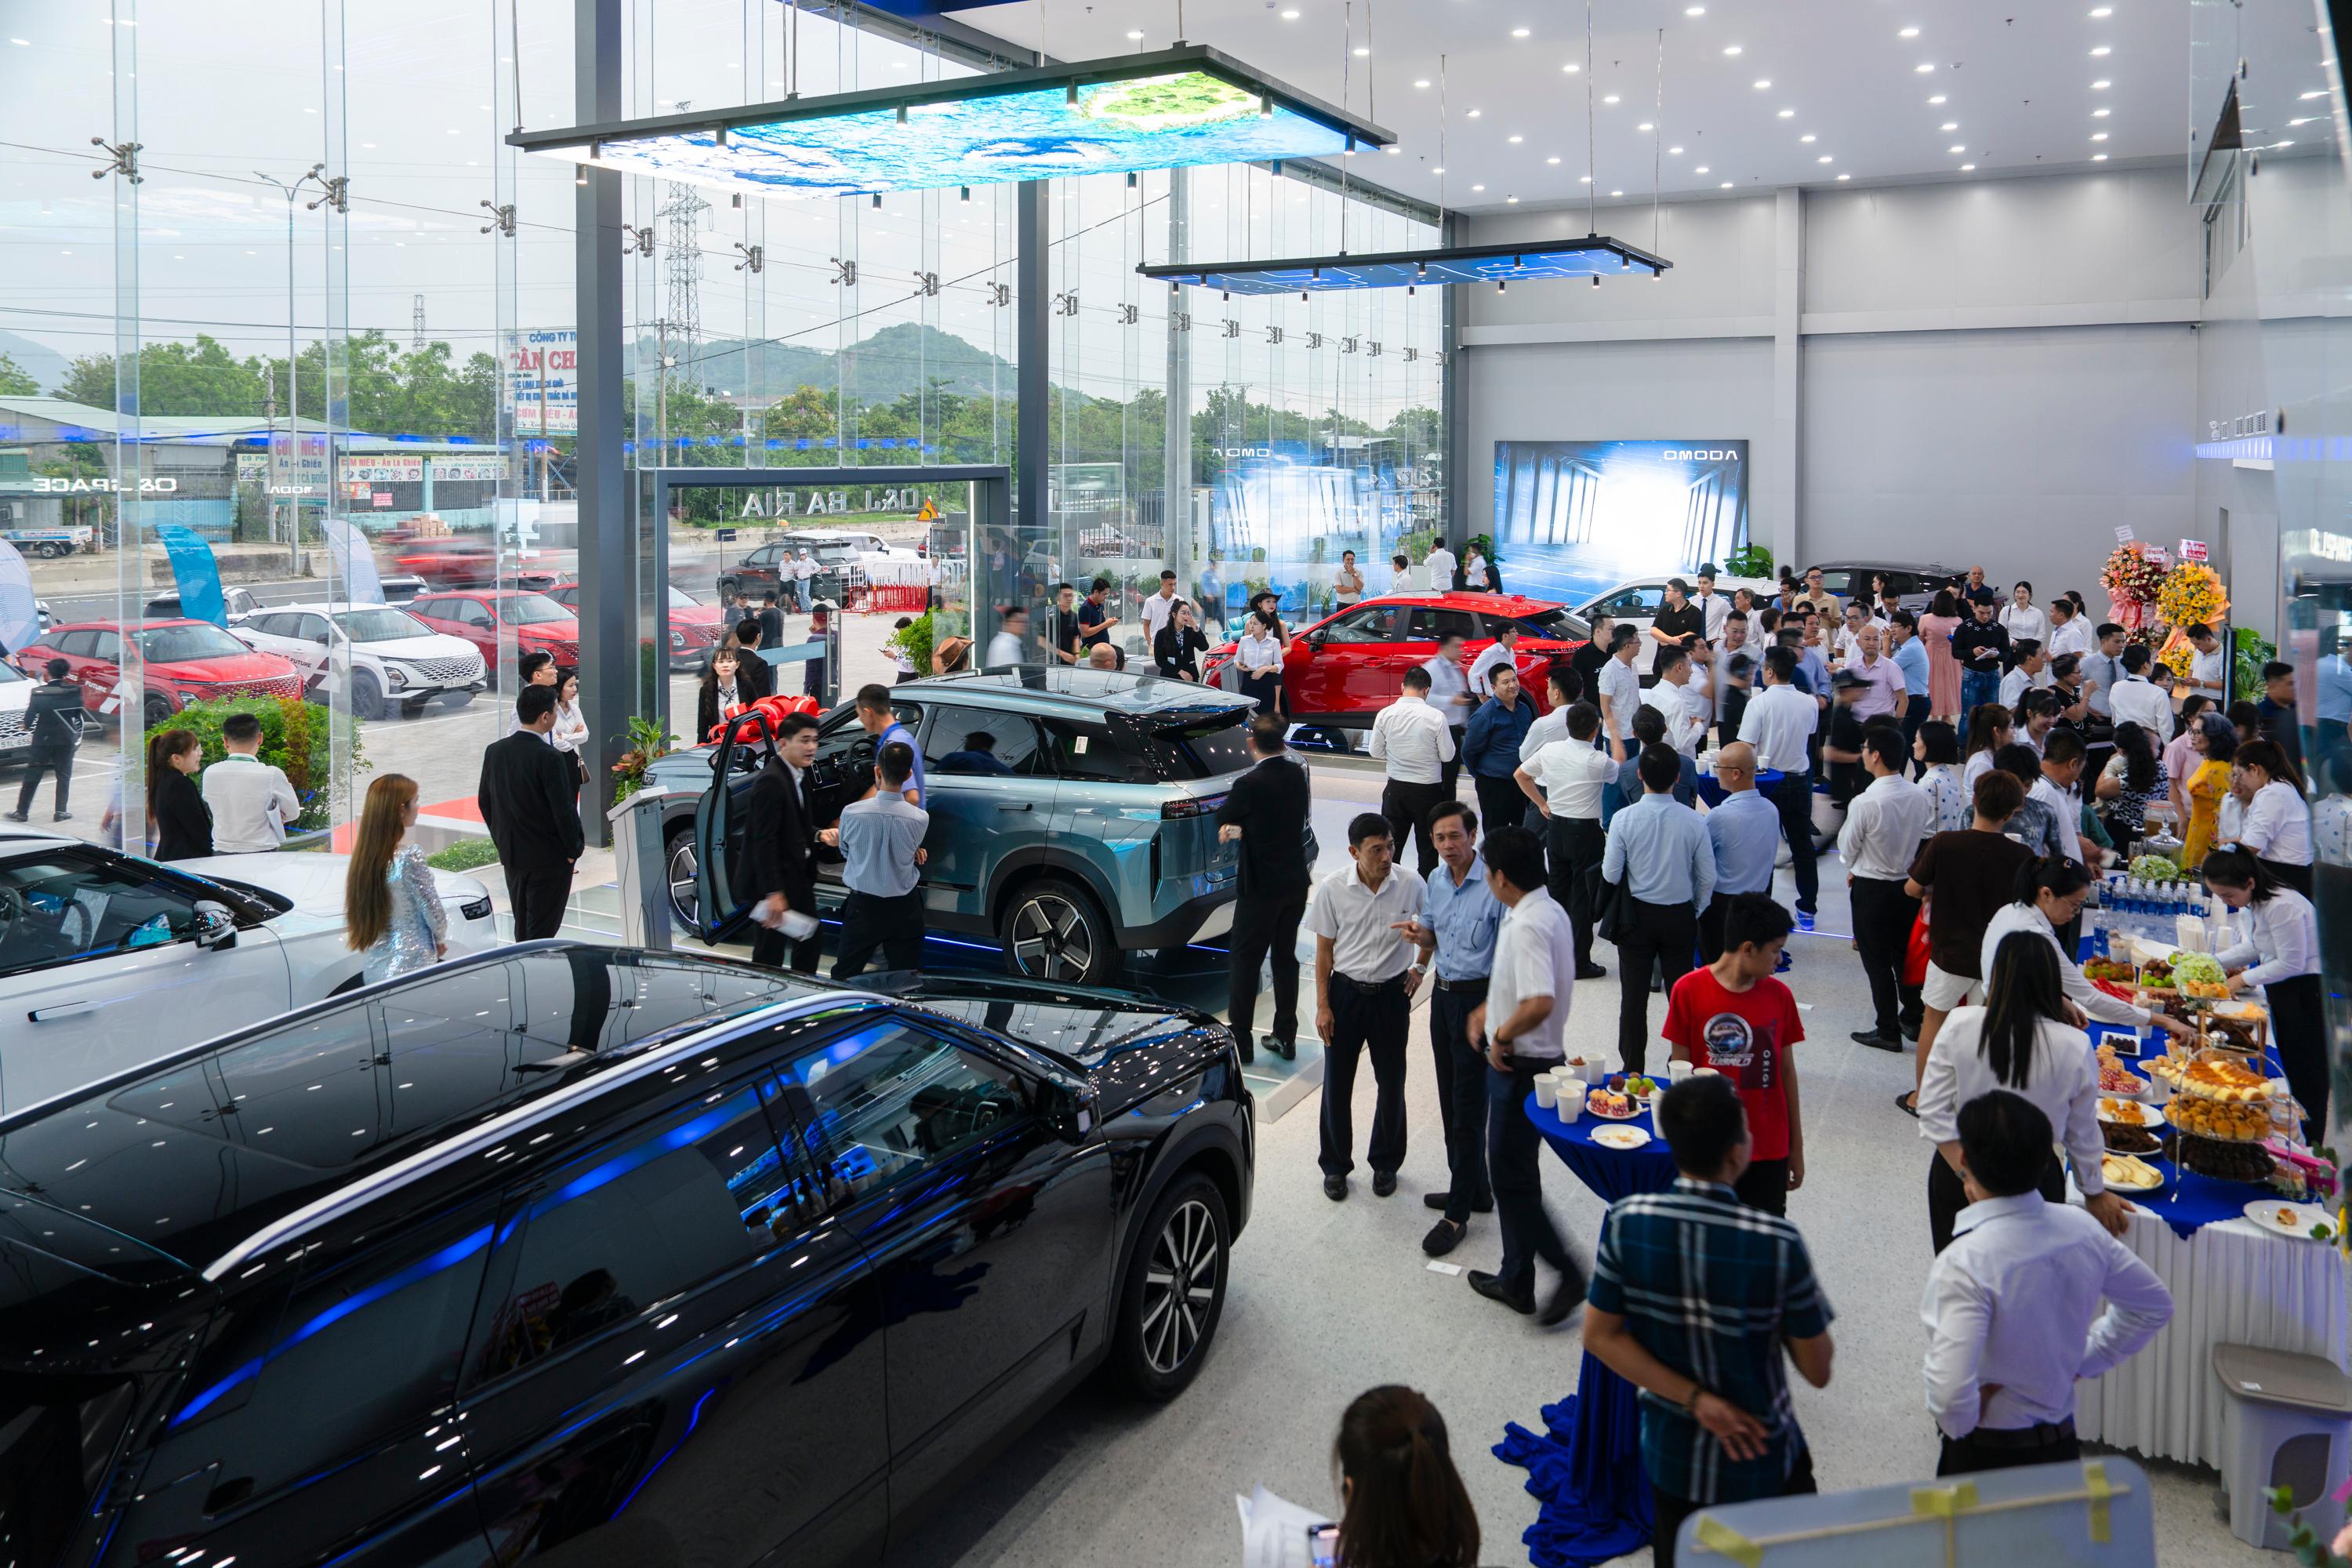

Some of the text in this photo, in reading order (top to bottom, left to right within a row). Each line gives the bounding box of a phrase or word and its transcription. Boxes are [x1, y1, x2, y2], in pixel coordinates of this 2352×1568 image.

[529, 330, 555, 343] CÔNG
[557, 332, 568, 342] TY
[549, 350, 577, 369] CH
[300, 437, 325, 456] NIÊU
[1664, 450, 1738, 460] OMODA
[340, 458, 357, 466] CM
[289, 658, 312, 668] FUTURE
[84, 680, 108, 693] FUTURE
